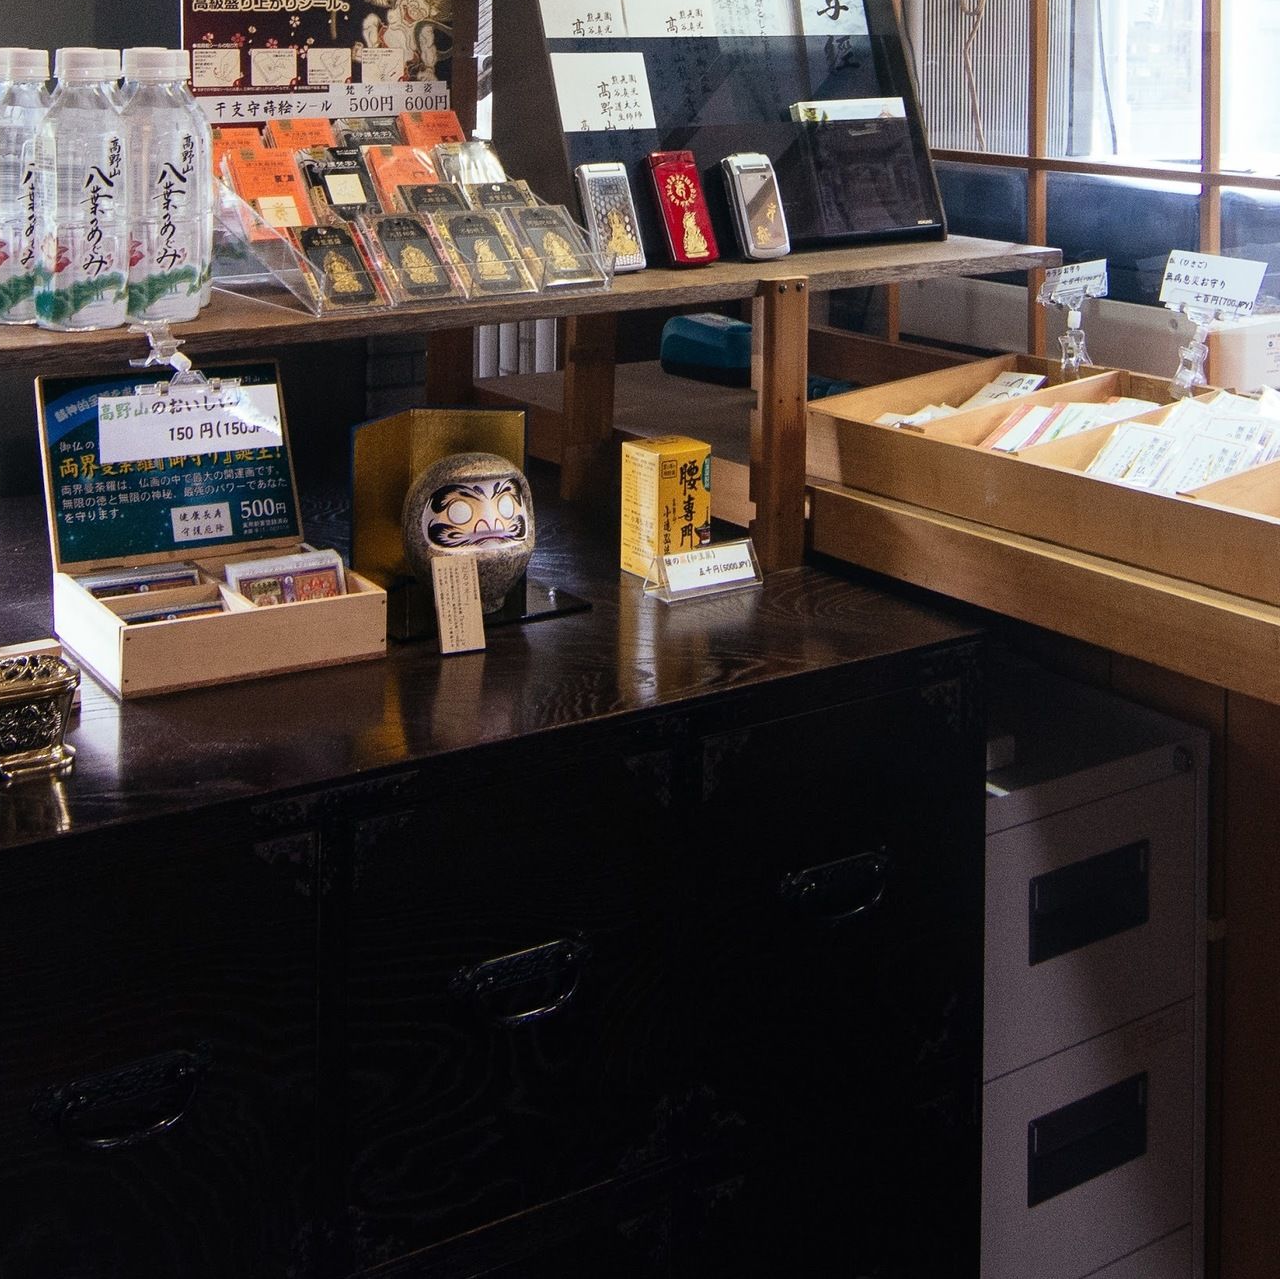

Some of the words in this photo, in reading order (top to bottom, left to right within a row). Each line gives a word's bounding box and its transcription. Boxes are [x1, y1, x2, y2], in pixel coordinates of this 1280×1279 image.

[215, 100, 333, 118] 干支守蒔絵シール
[349, 95, 394, 112] 500円
[405, 94, 449, 111] 600円
[109, 136, 122, 177] 高野山
[181, 134, 194, 174] 高野山
[81, 165, 114, 277] 八葉のめぐみ
[156, 162, 188, 271] 八葉のめぐみ
[240, 499, 286, 520] 500円
[677, 459, 701, 549] 腰専門
